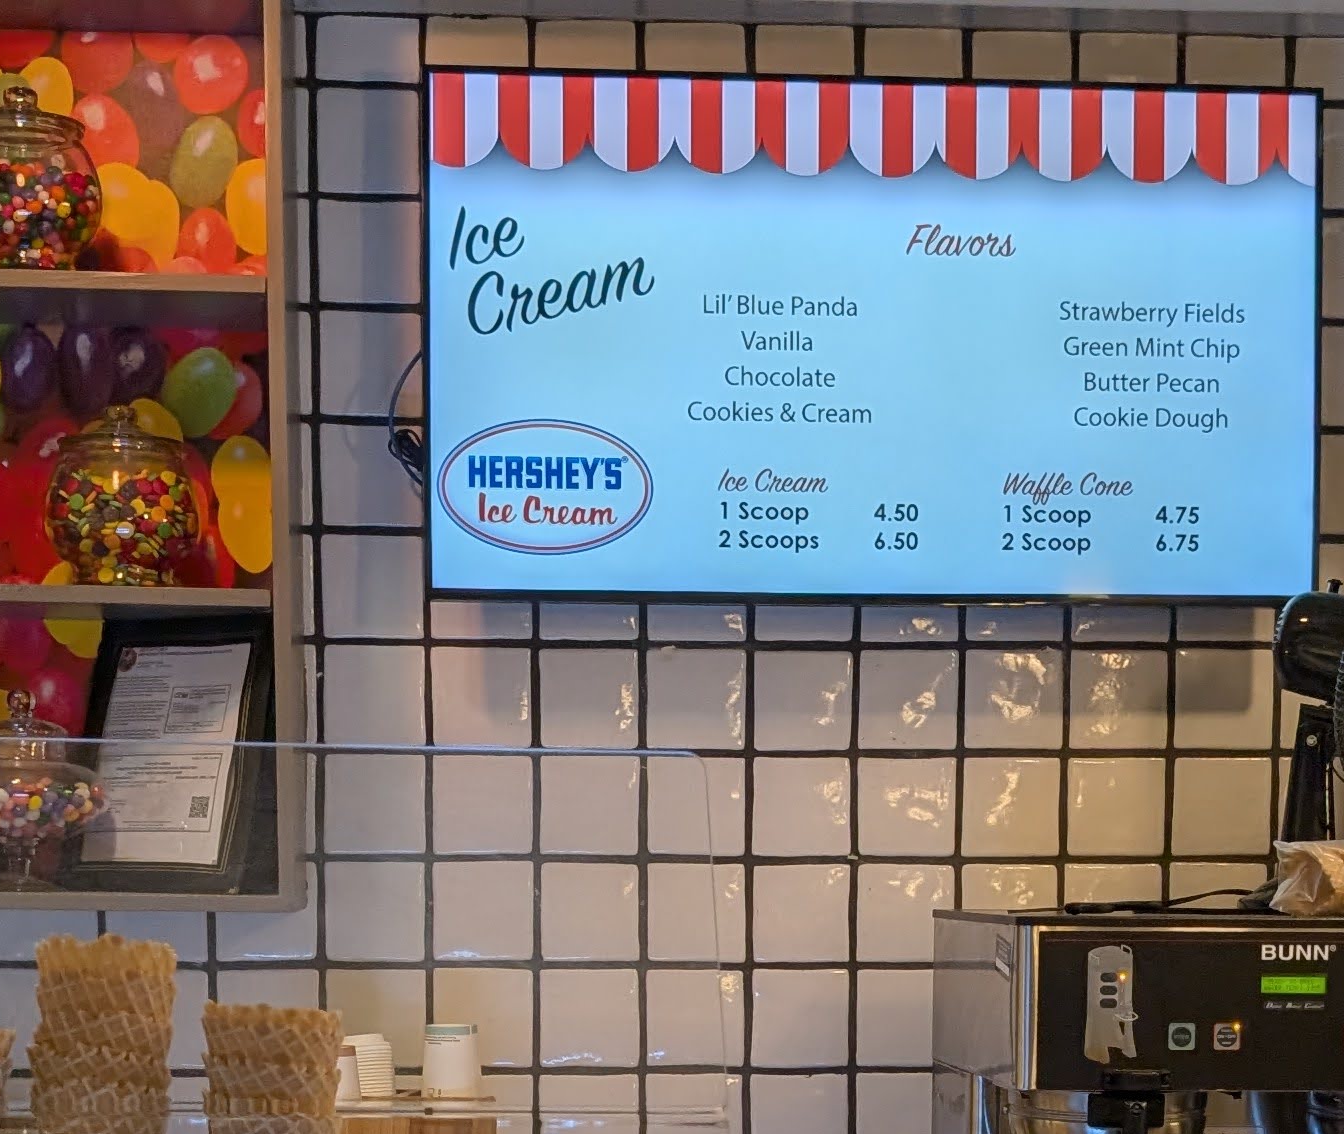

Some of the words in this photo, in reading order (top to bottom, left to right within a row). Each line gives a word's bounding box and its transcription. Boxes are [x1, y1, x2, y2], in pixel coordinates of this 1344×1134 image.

[449, 205, 525, 271] Ice
[905, 223, 1017, 258] Flavors
[467, 256, 655, 335] Cream
[702, 293, 733, 315] Lil'
[736, 294, 785, 316] Blue
[790, 295, 858, 318] Panda
[1058, 300, 1179, 328] Strawberry
[1184, 302, 1246, 324] Fields
[740, 330, 814, 352] Vanilla
[1063, 335, 1128, 357] Green
[1134, 337, 1185, 358] Mint
[1190, 337, 1241, 364] Chip
[724, 364, 836, 388] Chocolate
[1083, 371, 1151, 393] Butter
[1155, 372, 1220, 394] Pecan
[687, 400, 774, 422] Cookies
[779, 402, 796, 423] &
[801, 402, 873, 424] Cream
[1073, 406, 1149, 428] Cookie
[1155, 407, 1229, 434] Dough
[467, 454, 623, 490] HERSHEY'S
[717, 467, 749, 492] Ice
[754, 467, 829, 494] Cream
[1002, 471, 1074, 506] Waffle
[1079, 471, 1134, 497] Cone
[477, 491, 517, 524] Ice
[522, 494, 618, 526] Cream
[720, 501, 728, 520] 1
[738, 501, 810, 525] Scoop
[873, 503, 919, 522] 4.50
[1003, 504, 1011, 523] 1
[1021, 504, 1092, 528] Scoop
[1155, 505, 1200, 525] 4.75
[718, 529, 731, 549] 2
[738, 529, 820, 554] Scoops
[873, 531, 919, 551] 6.50
[1001, 532, 1015, 551] 2
[1021, 532, 1091, 555] Scoop
[1155, 533, 1200, 552] 6.75
